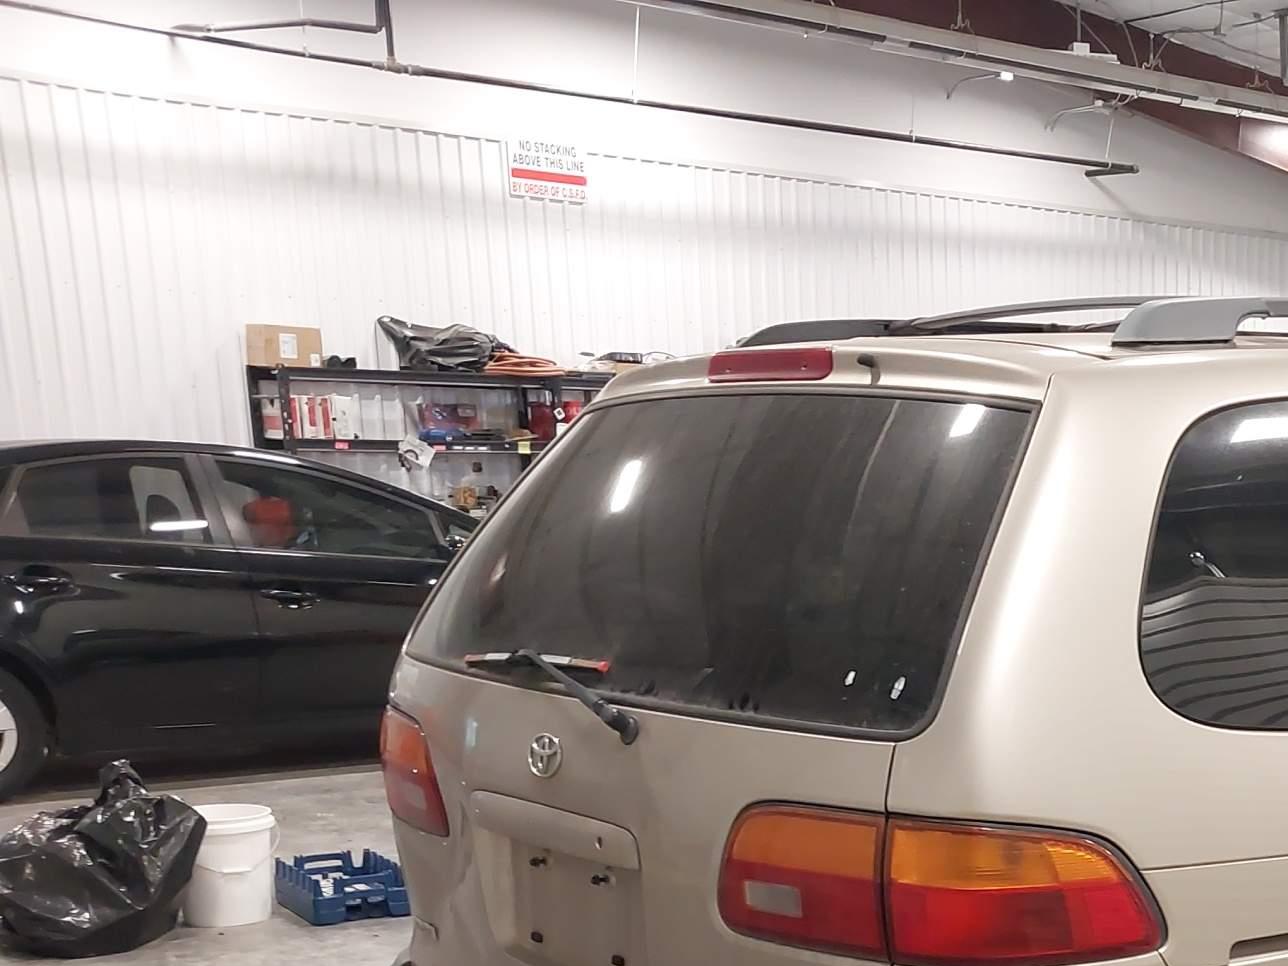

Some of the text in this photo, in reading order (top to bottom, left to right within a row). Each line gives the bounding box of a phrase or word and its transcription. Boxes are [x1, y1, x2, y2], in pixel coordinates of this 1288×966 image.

[519, 140, 577, 158] NO STACKING
[512, 153, 584, 173] ABOVE THIS LINE
[512, 182, 521, 193] BY
[524, 183, 548, 196] ORDER
[551, 186, 560, 197] OF
